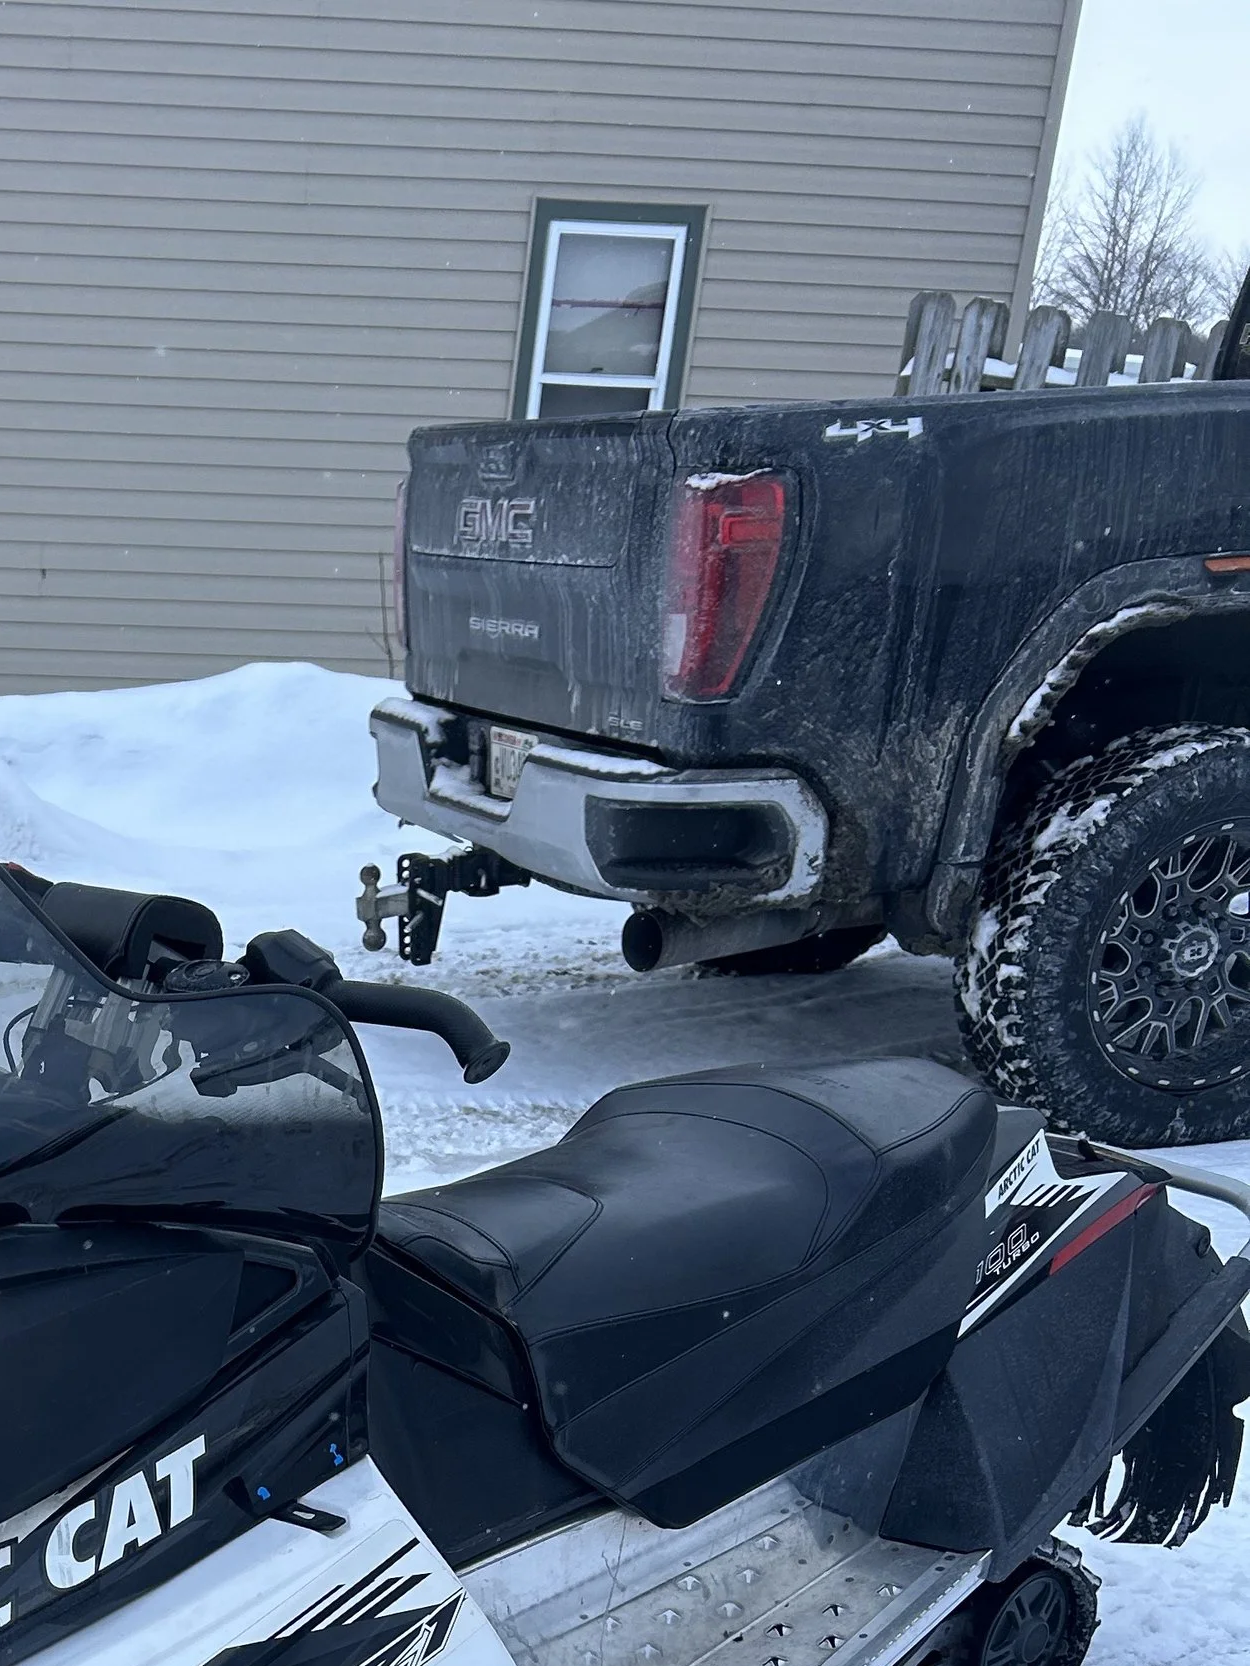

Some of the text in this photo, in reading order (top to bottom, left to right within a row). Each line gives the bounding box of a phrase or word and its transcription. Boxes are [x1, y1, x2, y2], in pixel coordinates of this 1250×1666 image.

[459, 497, 535, 544] GMC
[469, 616, 540, 640] SIERRA
[608, 716, 644, 731] SLE
[998, 1139, 1041, 1201] ARCTIC CAT
[993, 1231, 1040, 1276] TURBO
[43, 1434, 207, 1590] CAT
